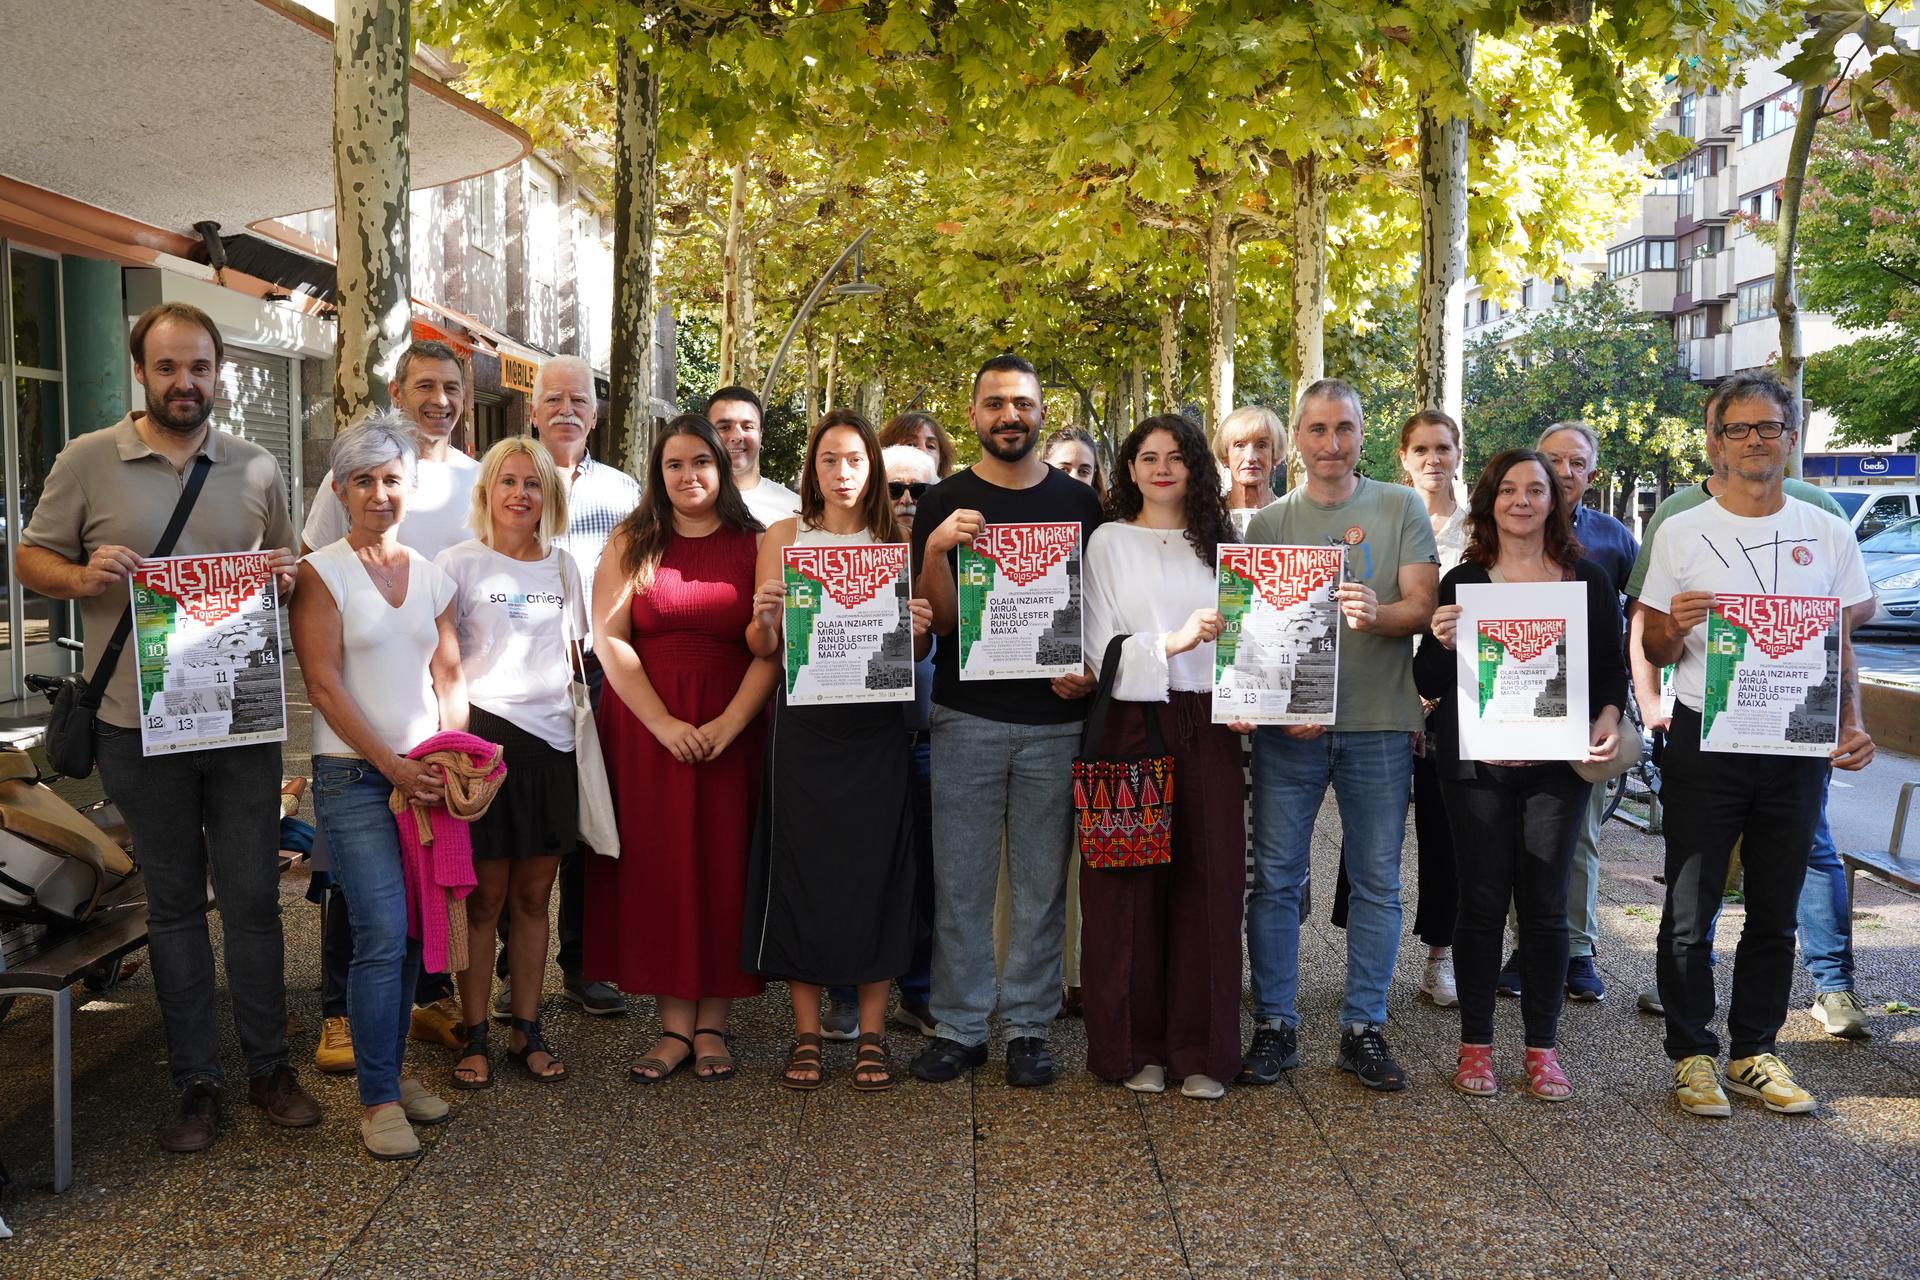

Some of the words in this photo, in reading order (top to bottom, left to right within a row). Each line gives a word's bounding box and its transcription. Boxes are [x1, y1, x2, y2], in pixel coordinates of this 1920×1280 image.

[972, 526, 1077, 557] ALESTiNAREN
[970, 564, 985, 585] 6
[1221, 573, 1231, 583] 6
[137, 591, 148, 603] 6
[262, 596, 272, 609] 9
[796, 586, 812, 608] 6
[817, 628, 846, 636] MIRUA
[1225, 621, 1239, 633] 10
[818, 643, 836, 651] RUH
[1319, 640, 1333, 651] 14
[1719, 632, 1736, 654] 6
[147, 643, 164, 656] 10
[1485, 646, 1497, 661] 6
[261, 651, 275, 664] 14
[1281, 653, 1290, 664] 11
[216, 671, 228, 683] 11
[1738, 669, 1766, 677] OLAIA
[1768, 670, 1809, 679] INZIARTE
[1738, 677, 1768, 685] MIRUA
[1218, 688, 1231, 698] 12
[1769, 685, 1802, 694] LESTER
[1244, 693, 1257, 704] 13
[147, 716, 164, 729] 12
[178, 718, 194, 731] 13
